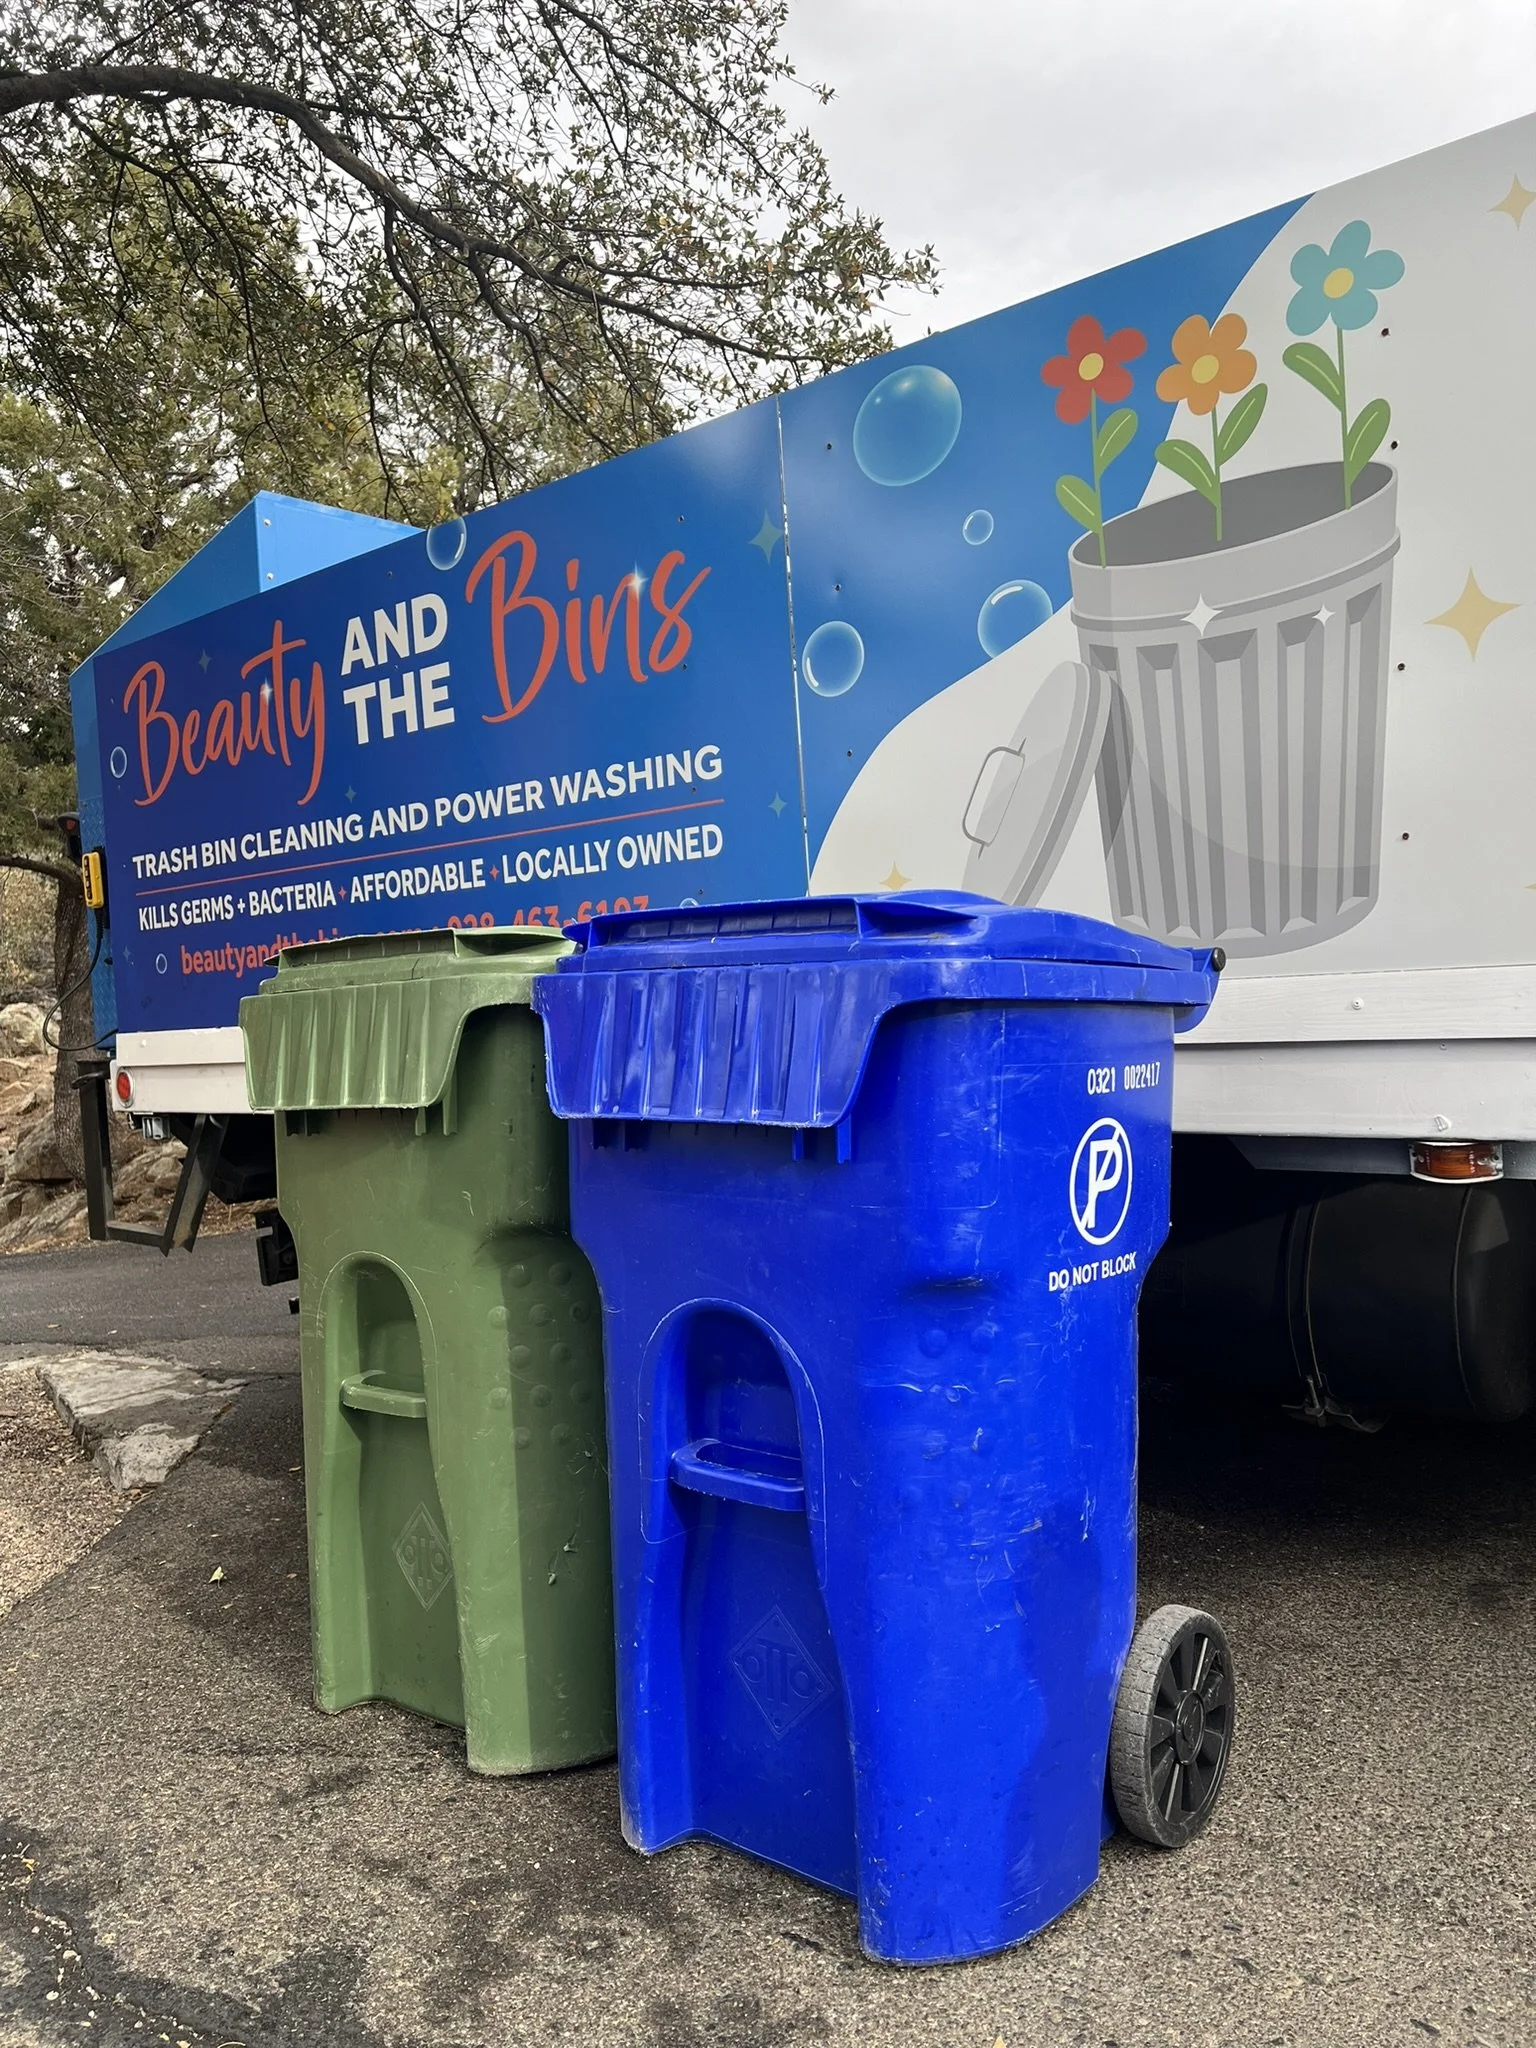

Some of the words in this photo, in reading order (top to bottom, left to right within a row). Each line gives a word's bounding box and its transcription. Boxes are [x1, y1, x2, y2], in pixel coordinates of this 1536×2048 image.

[340, 592, 448, 676] AND
[465, 530, 712, 723] Bins
[123, 619, 326, 806] Beauty
[342, 661, 456, 745] THE
[132, 845, 197, 879] TRASH
[201, 837, 237, 868] BIN
[240, 813, 364, 861] CLEANING
[369, 801, 429, 838] AND
[434, 779, 545, 827] POWER
[549, 744, 723, 806] WASHING
[138, 902, 179, 931] KILLS
[181, 894, 234, 926] GERMS
[249, 880, 337, 917] BACTERIA
[350, 857, 486, 904] AFFORDABLE
[501, 838, 611, 884] LOCALLY
[616, 823, 724, 869] OWNED
[1087, 1066, 1116, 1096] 0321
[1123, 1061, 1161, 1091] 0022417
[1048, 1268, 1070, 1292] DO
[1072, 1261, 1100, 1287] NOT
[1101, 1251, 1137, 1280] BLOCK
